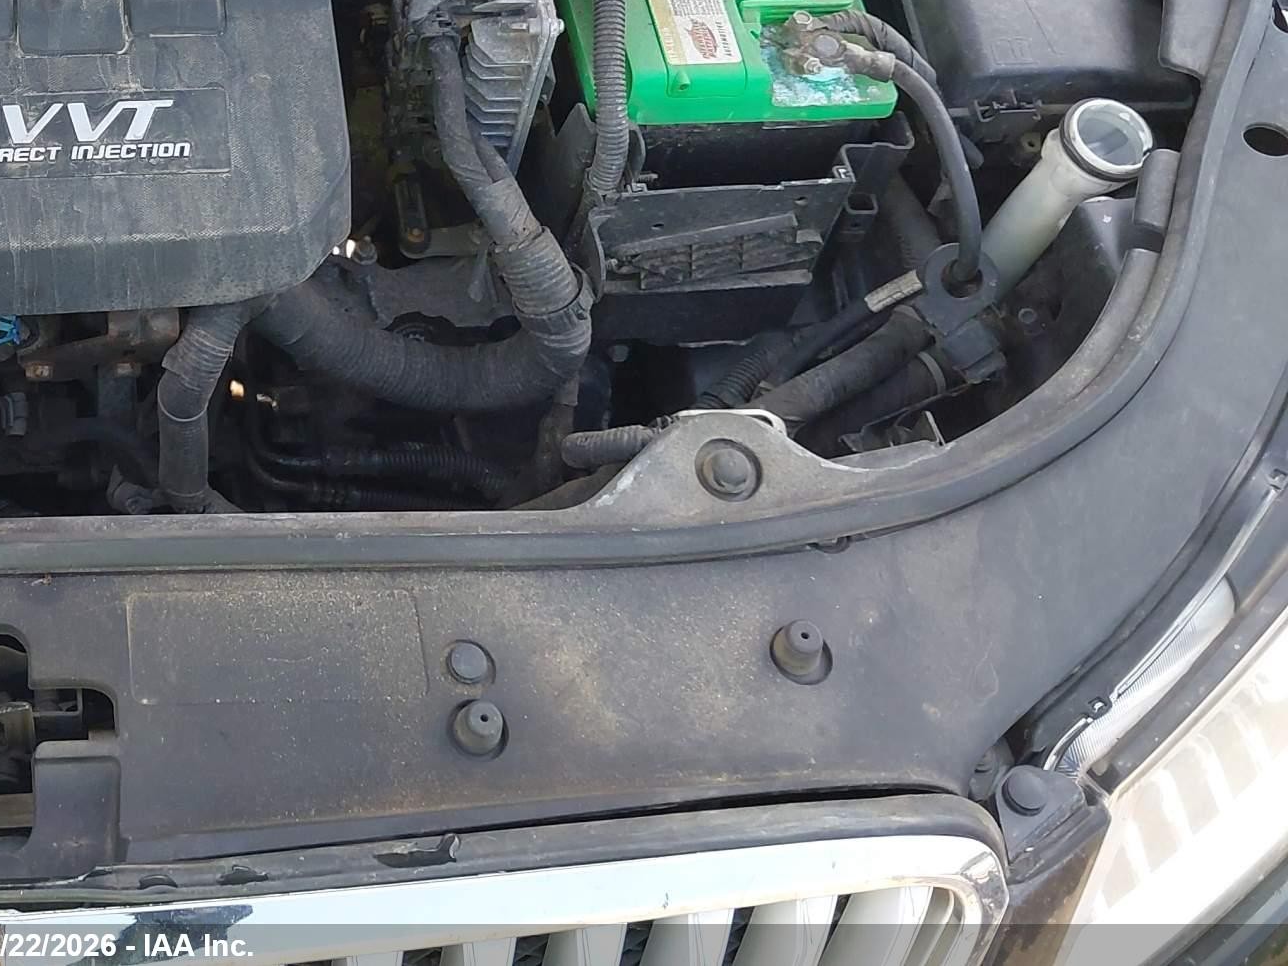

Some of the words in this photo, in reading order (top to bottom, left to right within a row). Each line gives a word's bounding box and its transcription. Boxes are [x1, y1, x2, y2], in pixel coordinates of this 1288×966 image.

[715, 21, 732, 56] AUTOMOTIVE
[2, 99, 174, 144] VVT
[70, 142, 191, 161] INJECTION
